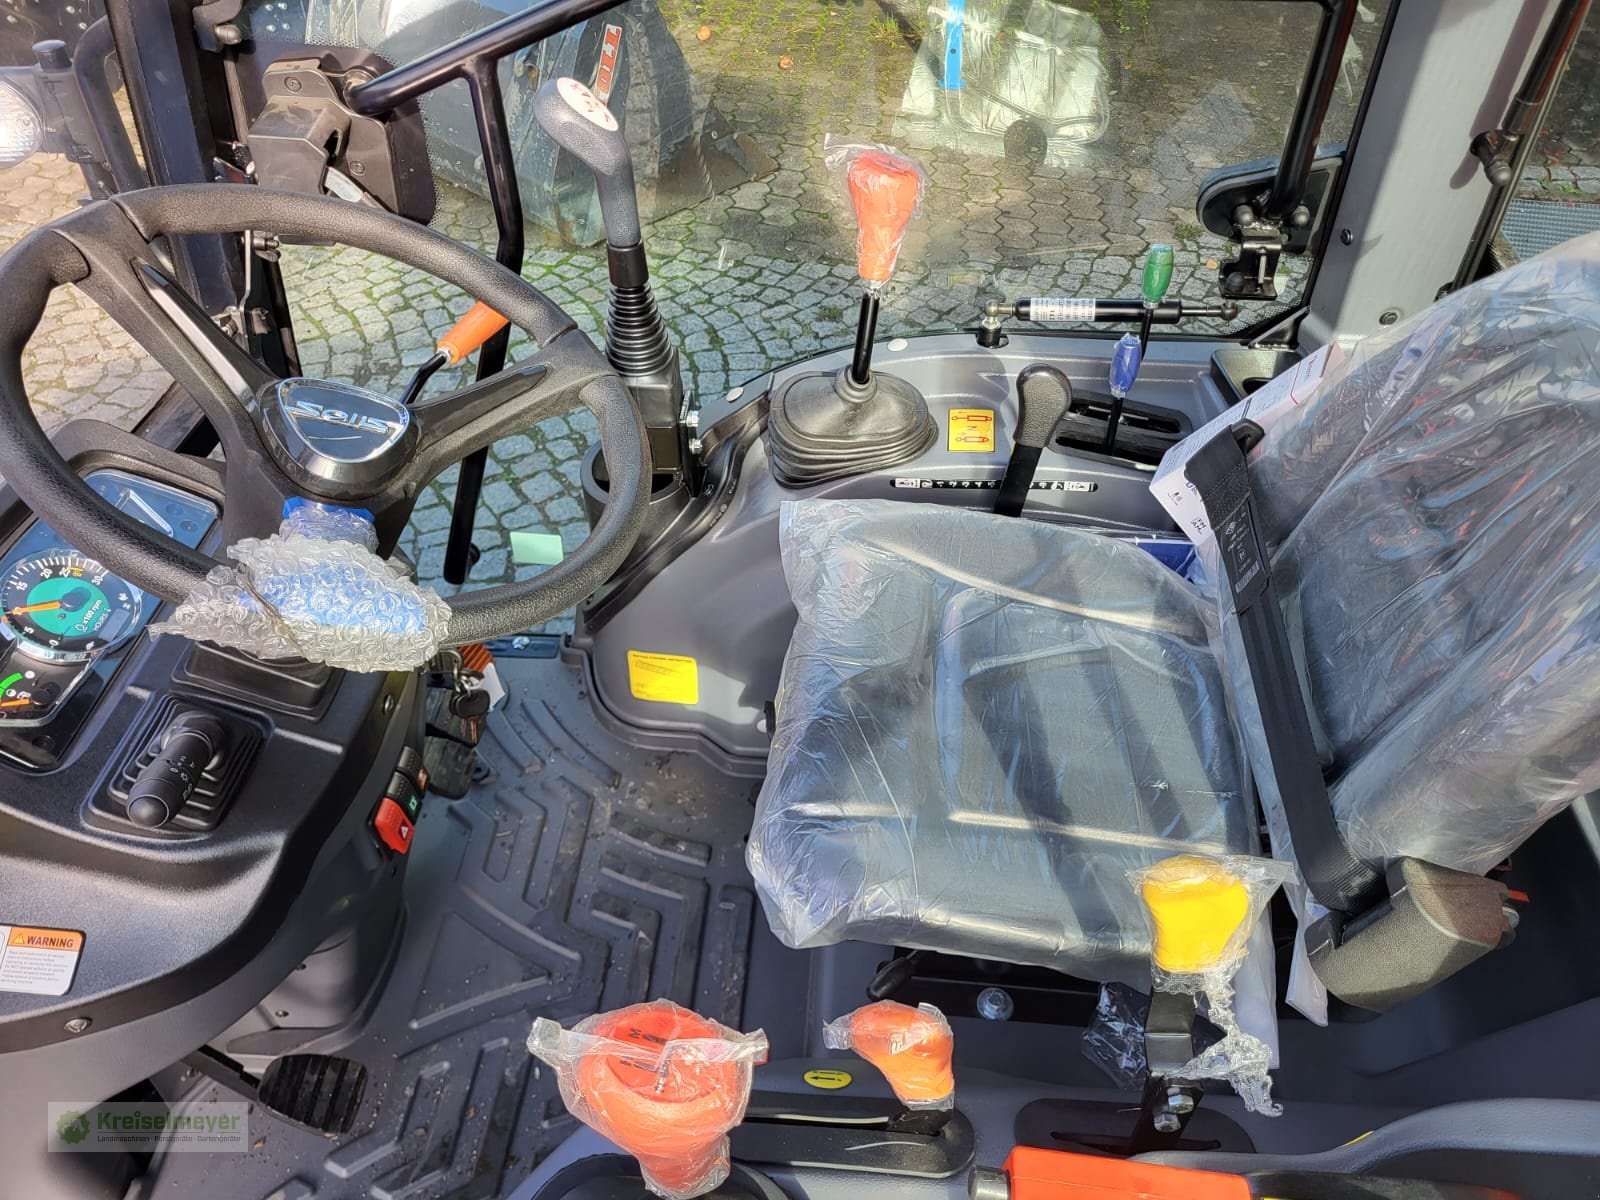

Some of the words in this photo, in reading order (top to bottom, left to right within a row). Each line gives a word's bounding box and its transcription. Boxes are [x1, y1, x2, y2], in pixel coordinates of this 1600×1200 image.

[40, 568, 53, 579] 20
[59, 567, 71, 578] 25
[16, 581, 28, 591] 15
[91, 575, 103, 586] 30
[24, 626, 34, 634] 5
[27, 935, 74, 948] WARNING
